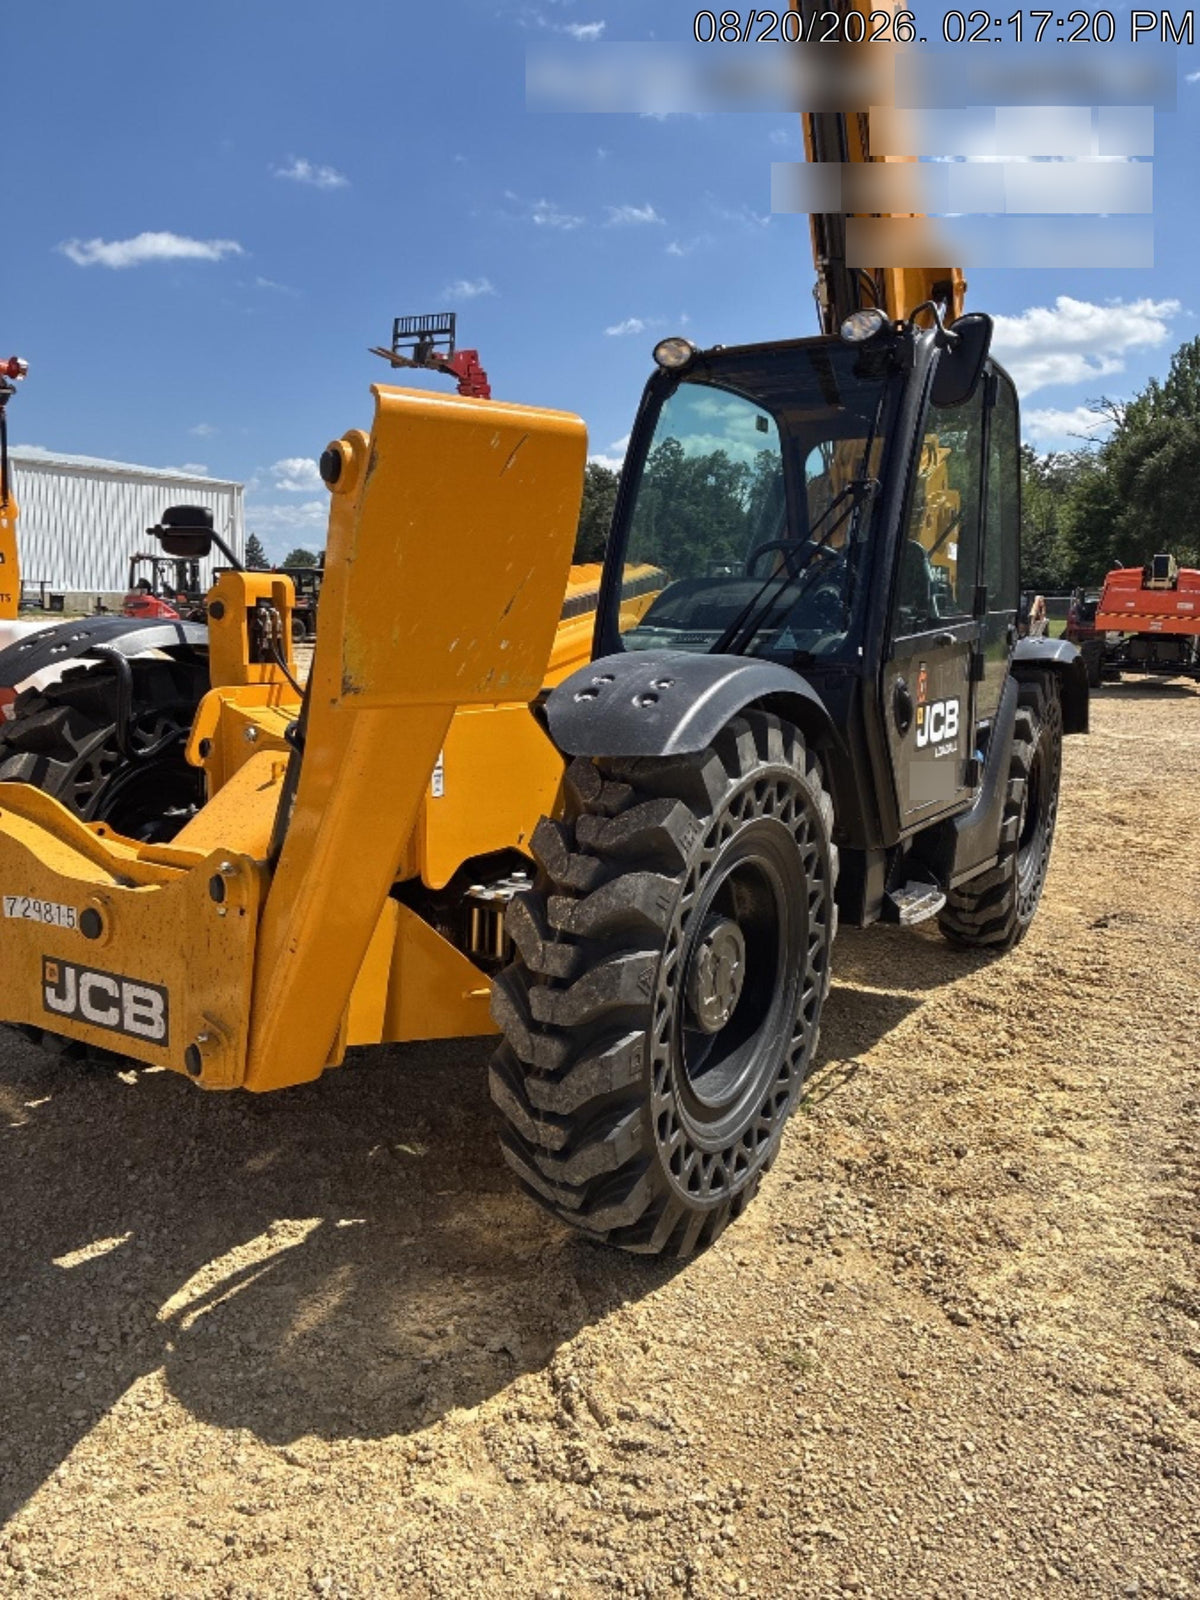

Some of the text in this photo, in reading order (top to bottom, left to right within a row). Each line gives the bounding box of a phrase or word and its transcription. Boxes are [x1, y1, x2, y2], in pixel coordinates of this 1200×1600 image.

[917, 699, 960, 748] JCB
[6, 896, 77, 929] 729815
[45, 965, 167, 1040] JCB
